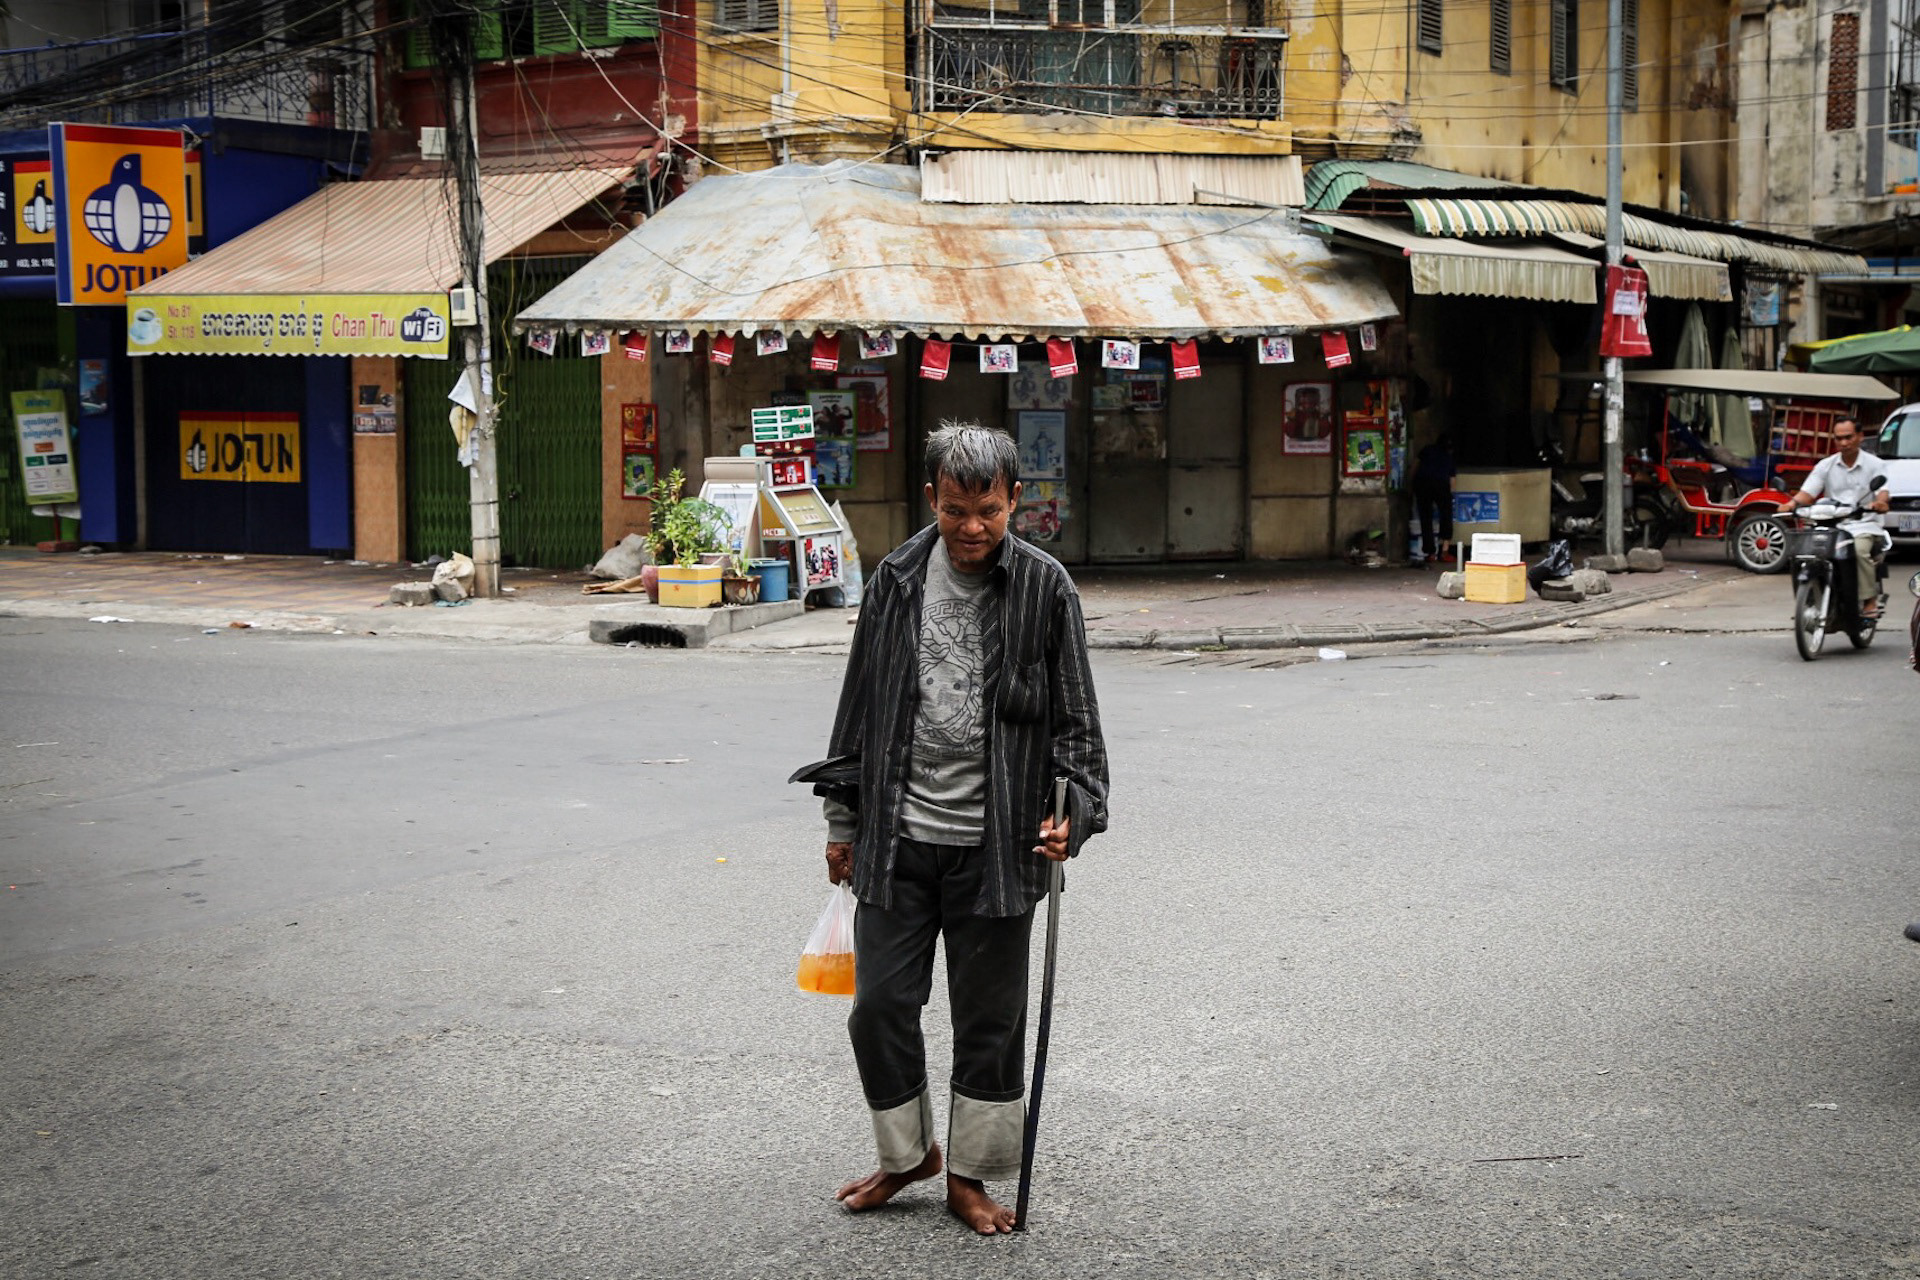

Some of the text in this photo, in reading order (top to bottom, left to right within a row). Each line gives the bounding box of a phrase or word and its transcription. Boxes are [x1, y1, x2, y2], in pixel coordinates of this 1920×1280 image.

[82, 264, 175, 293] JOTU
[332, 313, 395, 337] Chan Thu
